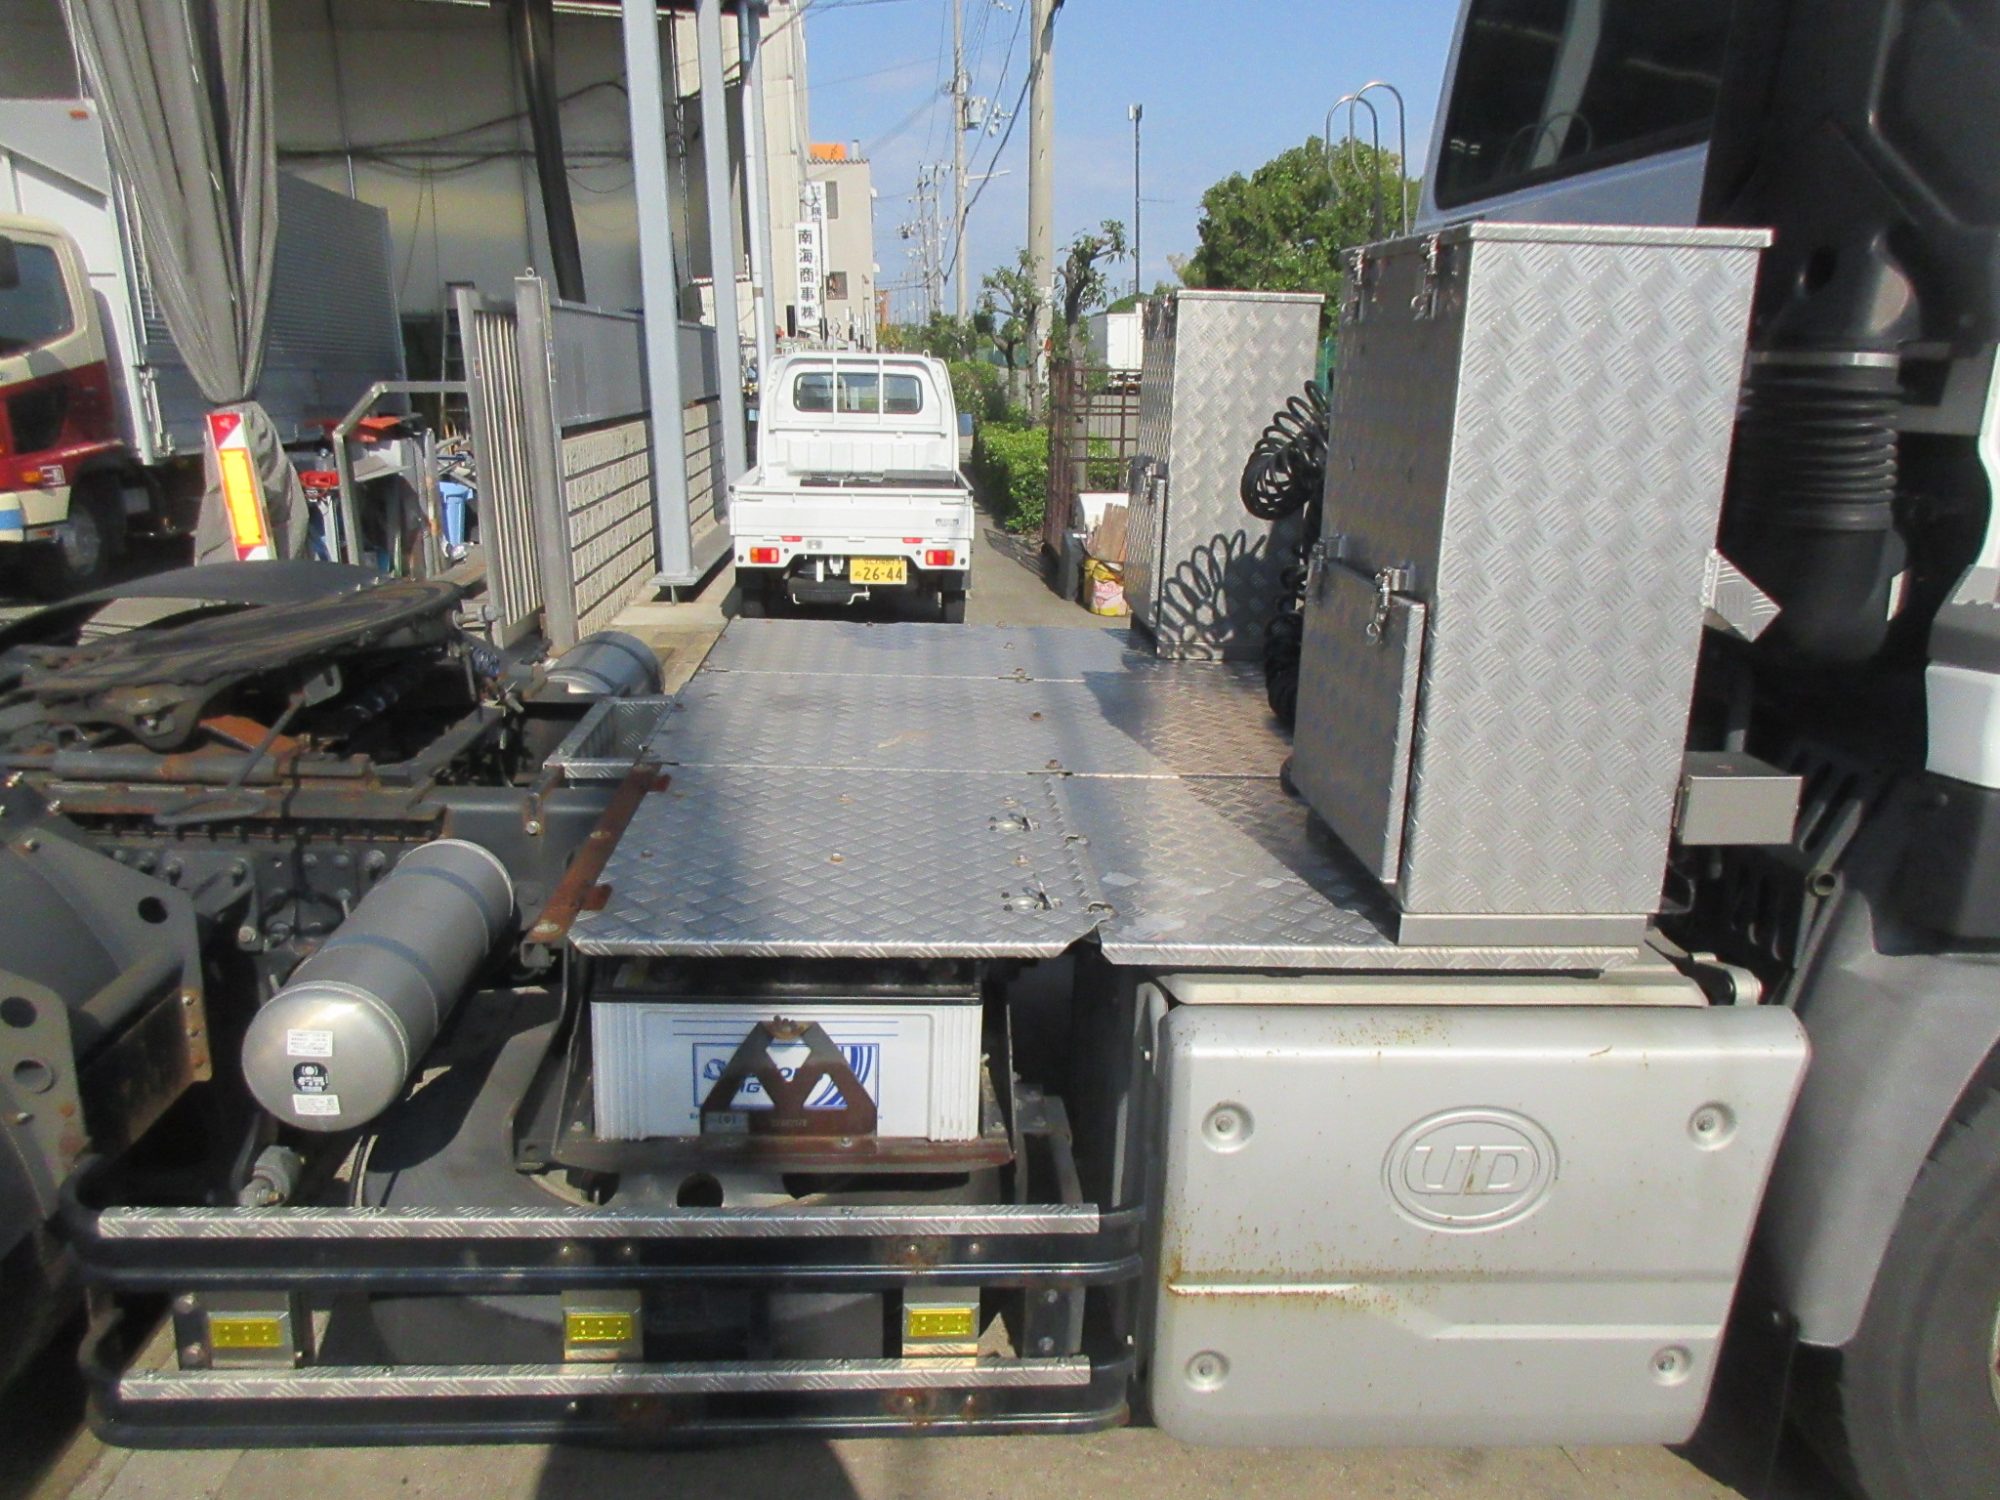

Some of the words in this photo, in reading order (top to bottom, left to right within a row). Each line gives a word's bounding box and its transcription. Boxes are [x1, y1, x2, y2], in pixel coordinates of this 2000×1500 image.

[799, 229, 815, 320] 南海商事株
[863, 566, 903, 581] 26-44
[1404, 1145, 1536, 1195] UD
